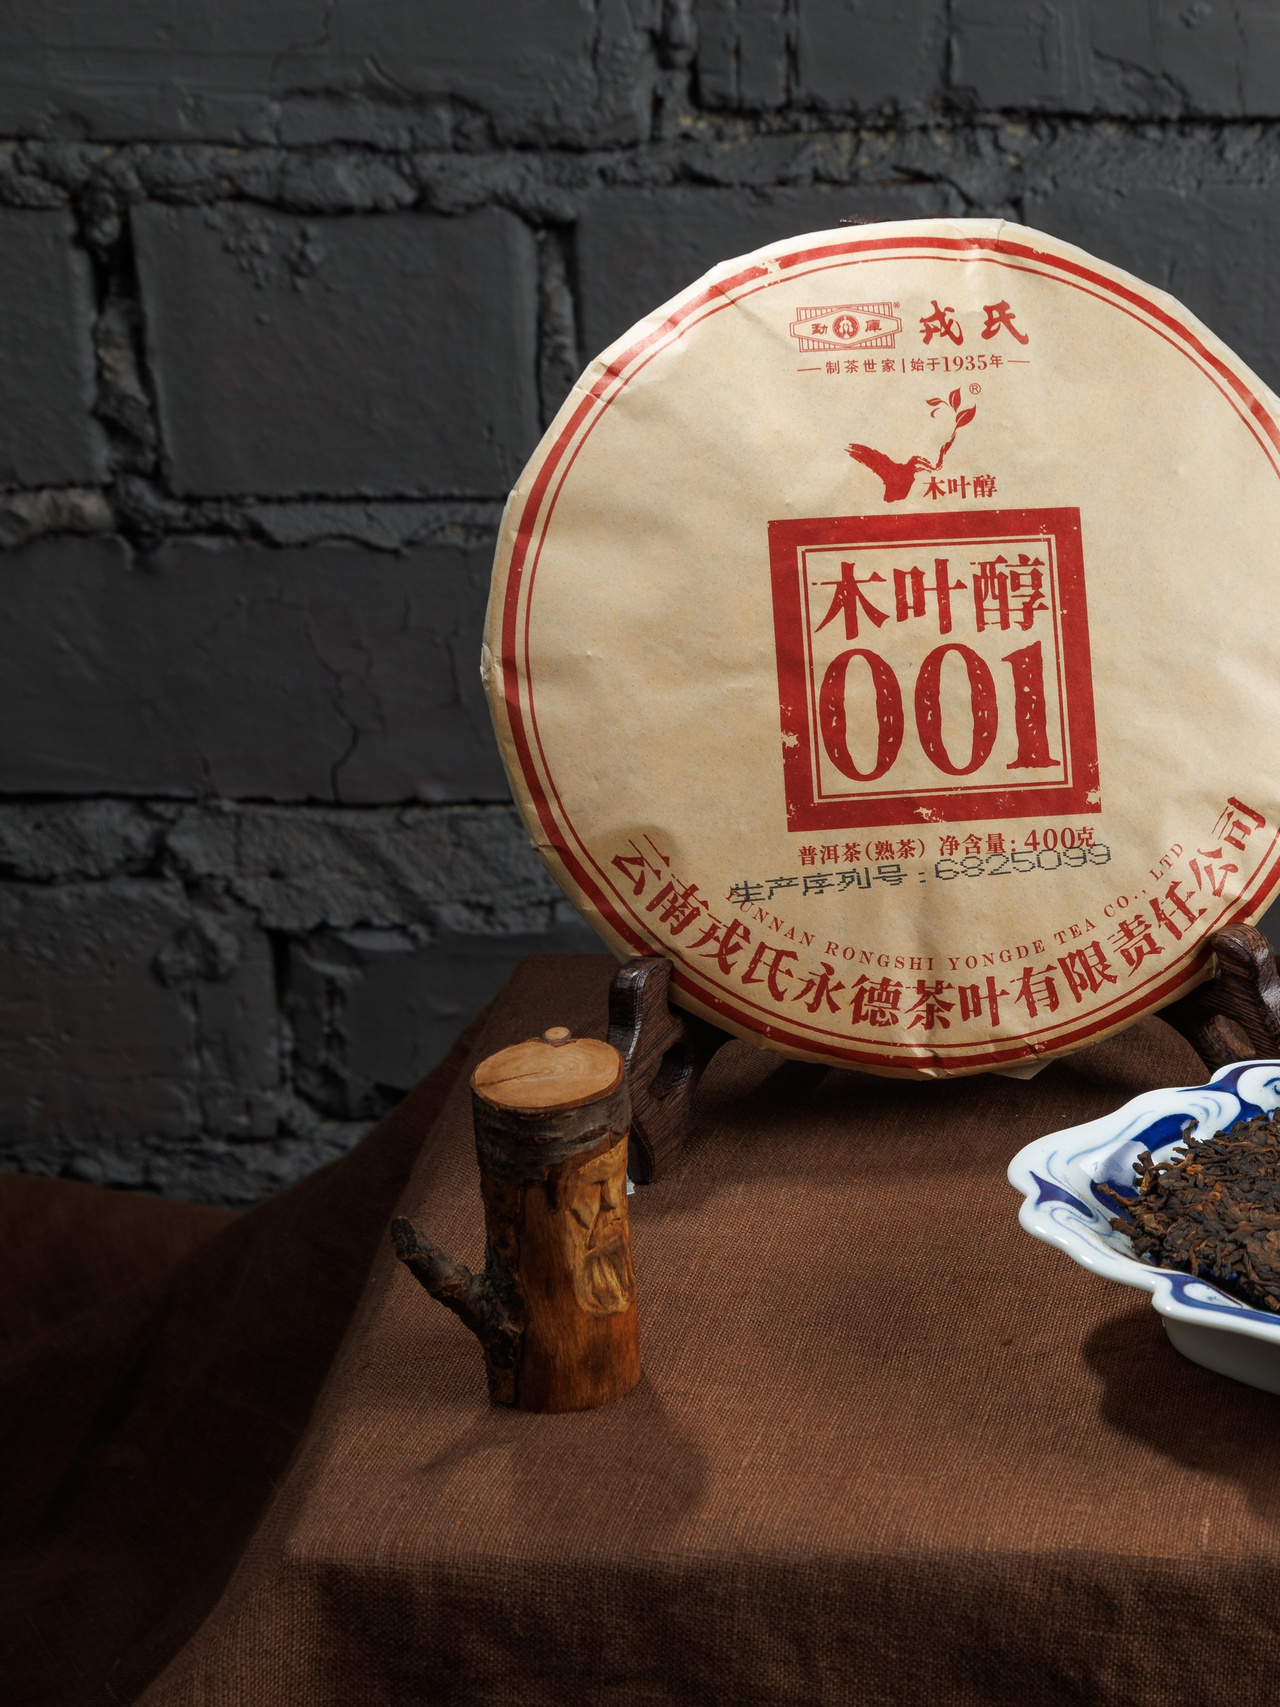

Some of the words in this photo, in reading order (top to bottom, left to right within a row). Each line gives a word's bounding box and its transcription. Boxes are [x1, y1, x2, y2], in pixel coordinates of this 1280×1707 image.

[922, 474, 998, 500] 木叶醇
[811, 553, 1050, 641] 木叶醇
[819, 640, 1061, 782] 001
[611, 796, 1267, 1031] 云南戎氏永德茶叶有限责任公司
[725, 886, 815, 947] YUNNAN
[824, 940, 934, 971] RONGSHI
[947, 939, 1046, 970] YONGDE
[1053, 918, 1096, 945] TEA
[1149, 843, 1184, 881] LTD
